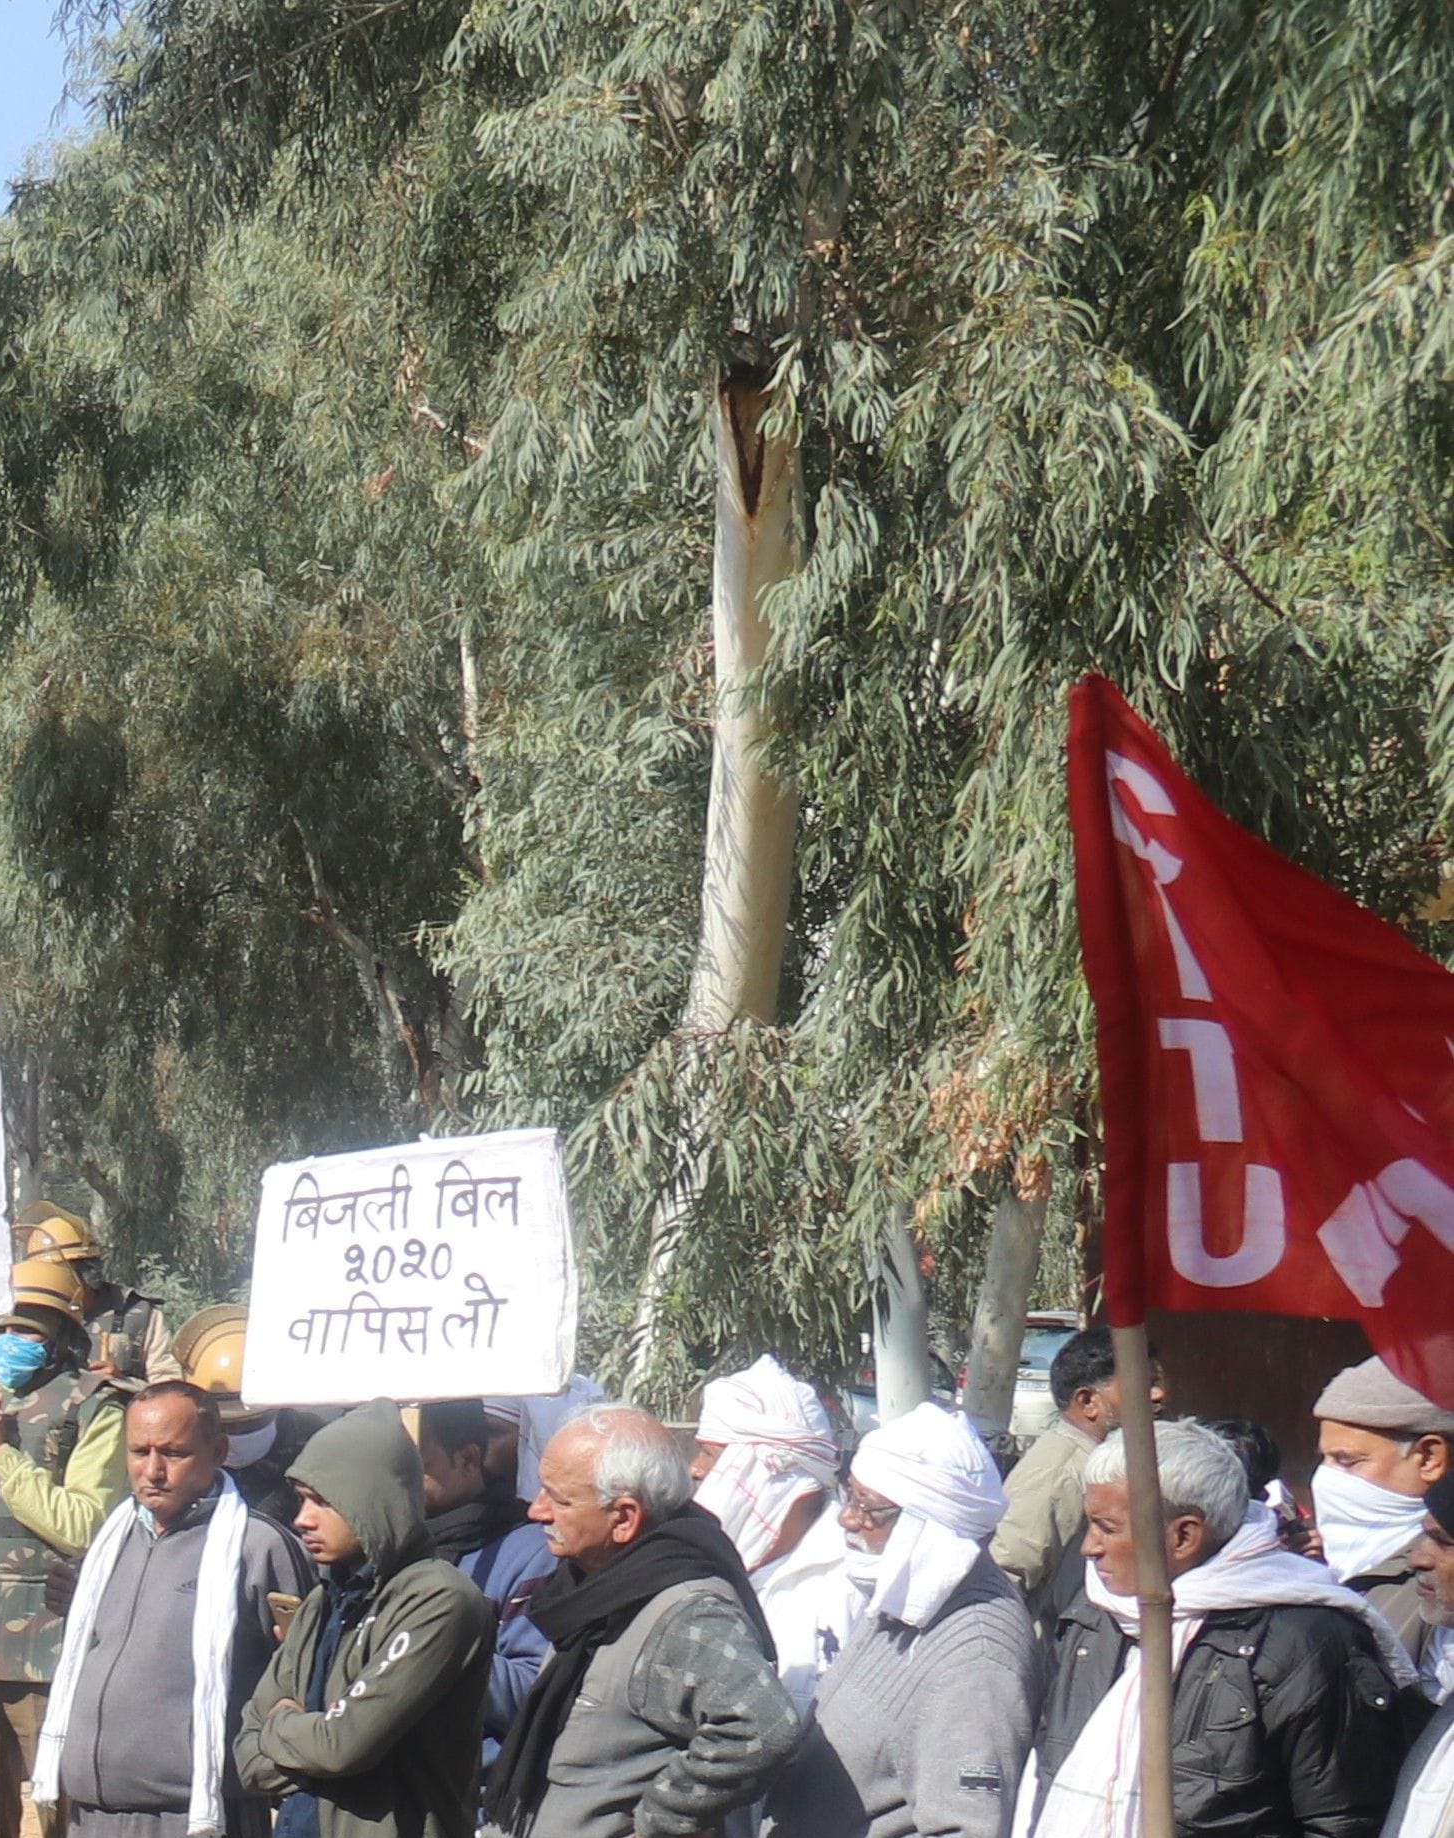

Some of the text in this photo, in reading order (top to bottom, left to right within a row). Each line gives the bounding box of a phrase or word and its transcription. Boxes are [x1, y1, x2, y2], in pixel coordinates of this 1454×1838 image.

[282, 1160, 522, 1243] बिजली बिल
[288, 1272, 509, 1355] वापिस लो
